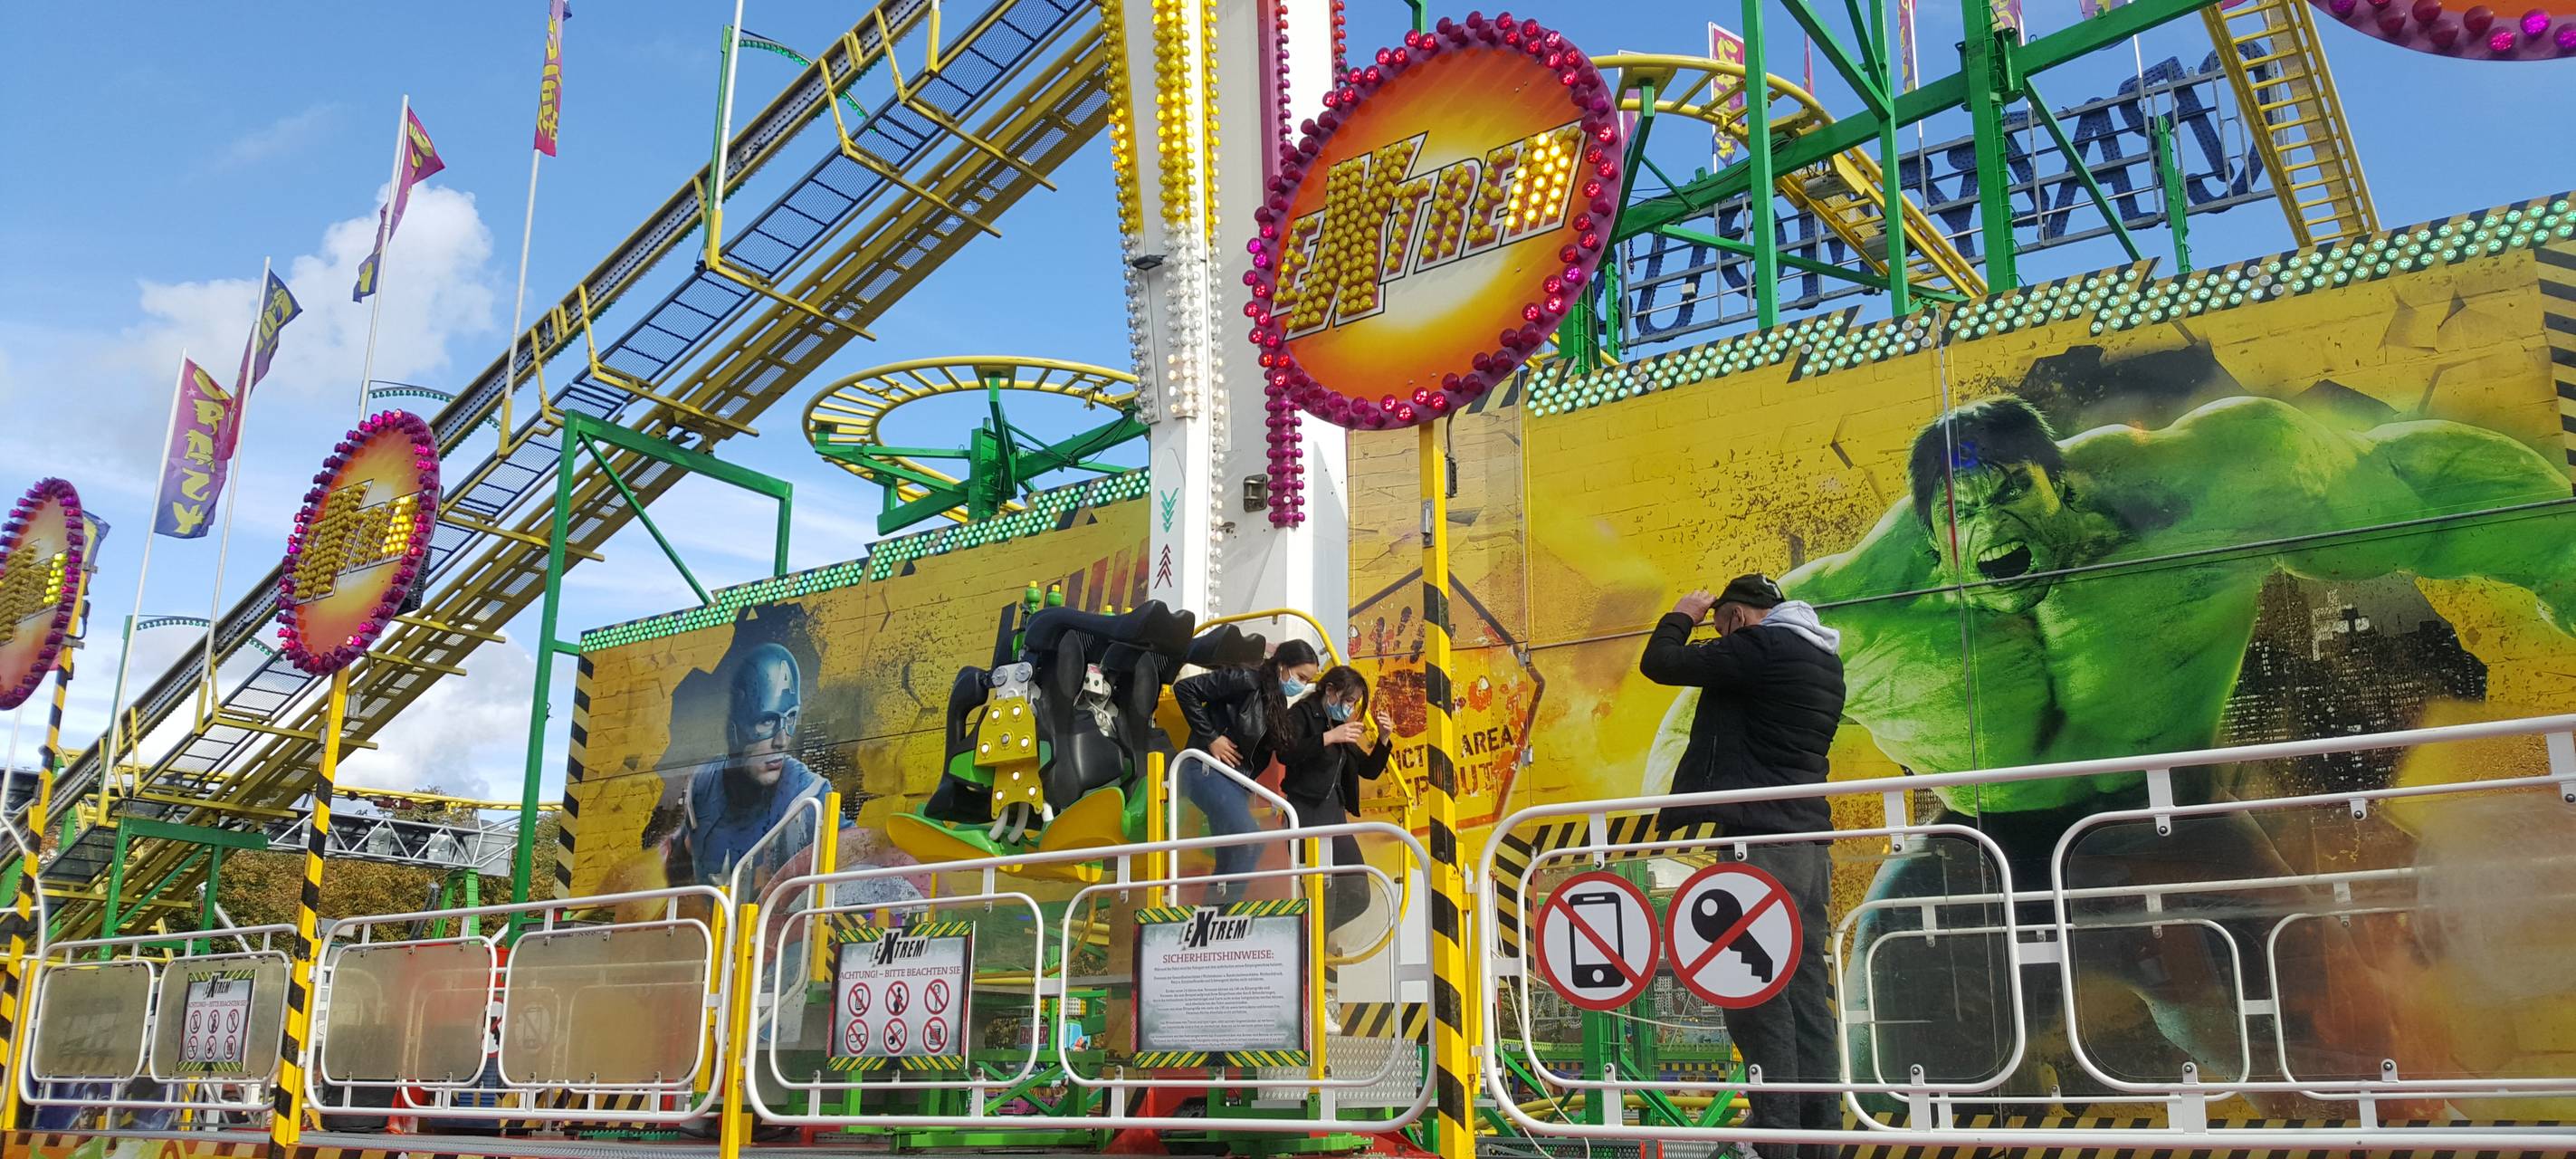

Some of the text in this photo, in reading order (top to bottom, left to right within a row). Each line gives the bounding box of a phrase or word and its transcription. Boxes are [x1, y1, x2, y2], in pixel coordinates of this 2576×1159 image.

[1270, 121, 1584, 340] EXTREM
[1460, 724, 1514, 758] AREA
[1184, 910, 1248, 948] EXTREM
[873, 932, 926, 965] EXTREM
[1162, 949, 1274, 964] SICHERHEITSHINWEISE:
[839, 970, 878, 980] ACHTUNG!
[884, 968, 905, 978] BITTE
[906, 966, 948, 977] BEACHTEN
[949, 965, 961, 975] SIE
